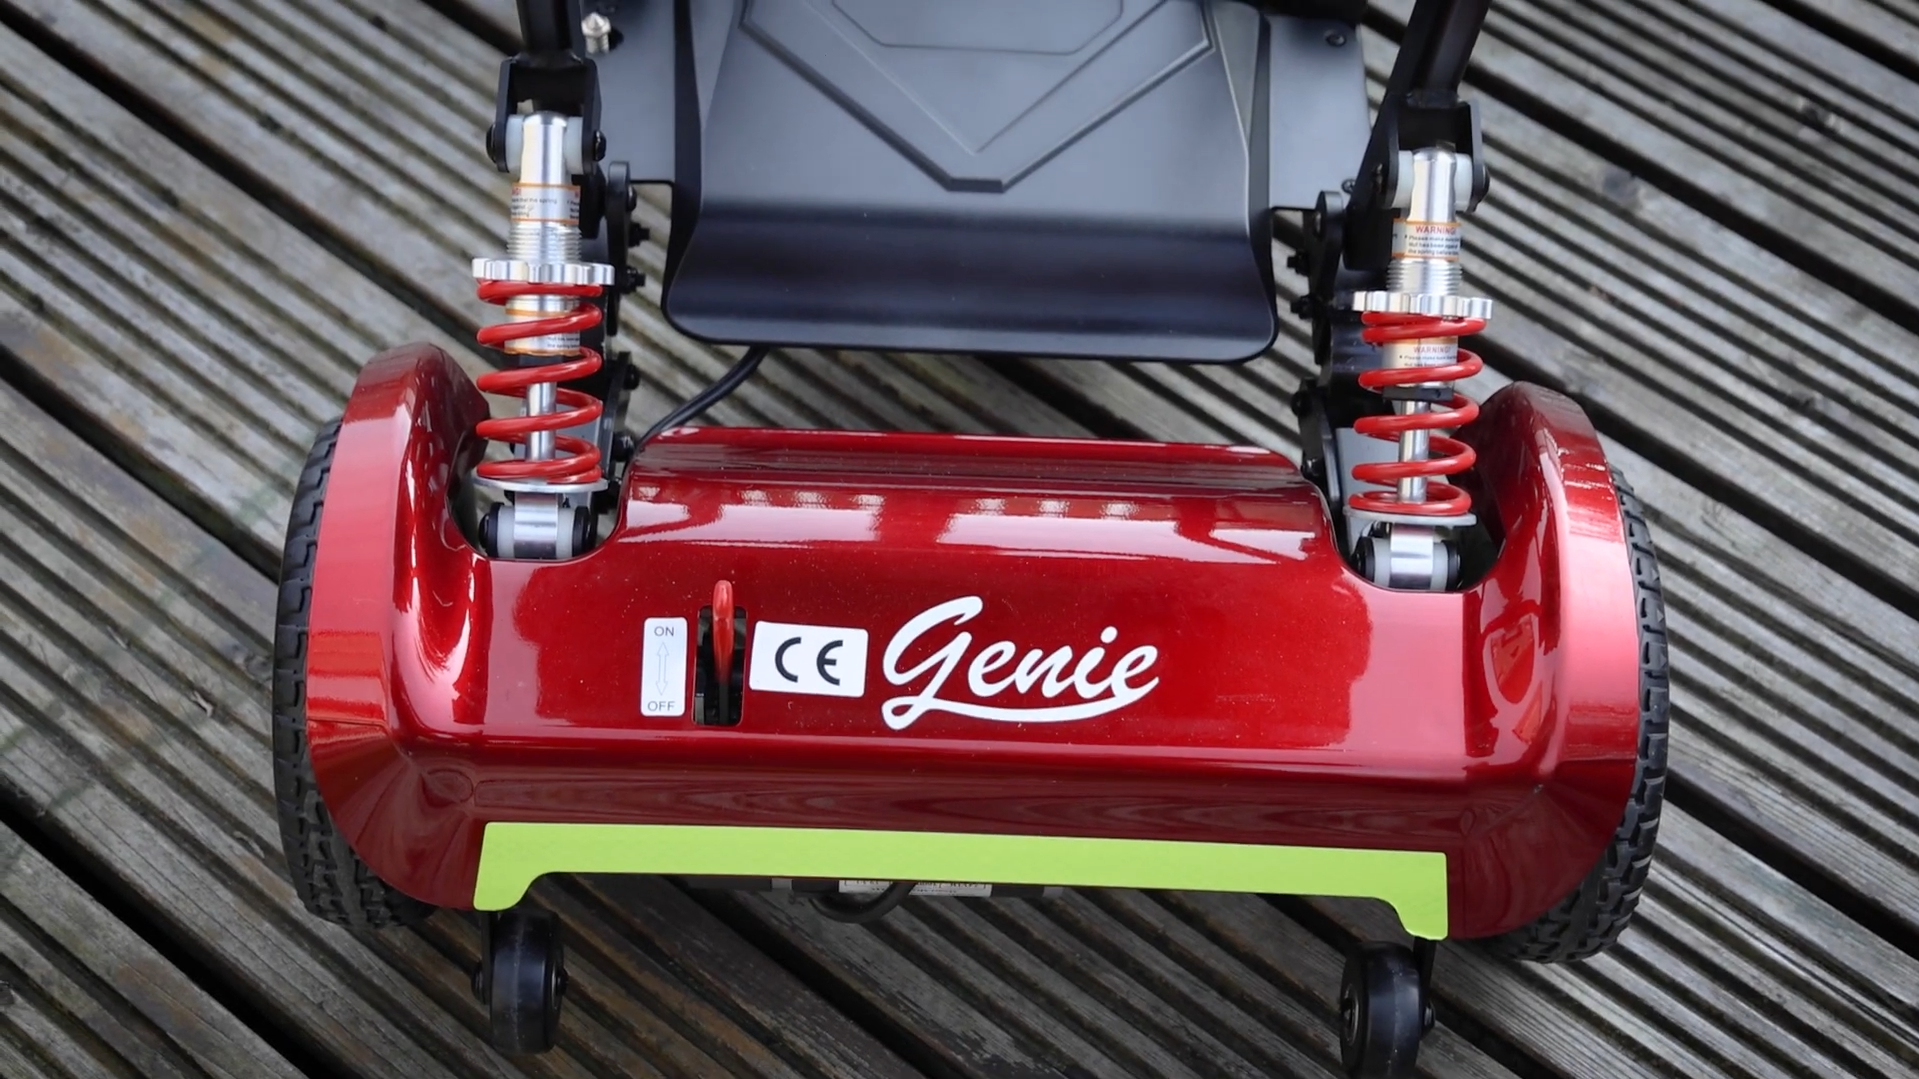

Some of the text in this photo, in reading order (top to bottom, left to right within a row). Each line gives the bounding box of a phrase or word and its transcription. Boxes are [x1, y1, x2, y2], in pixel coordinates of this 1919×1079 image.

[654, 626, 675, 637] ON
[774, 636, 843, 686] CE
[882, 596, 1159, 730] Genie
[647, 701, 676, 711] OFF
